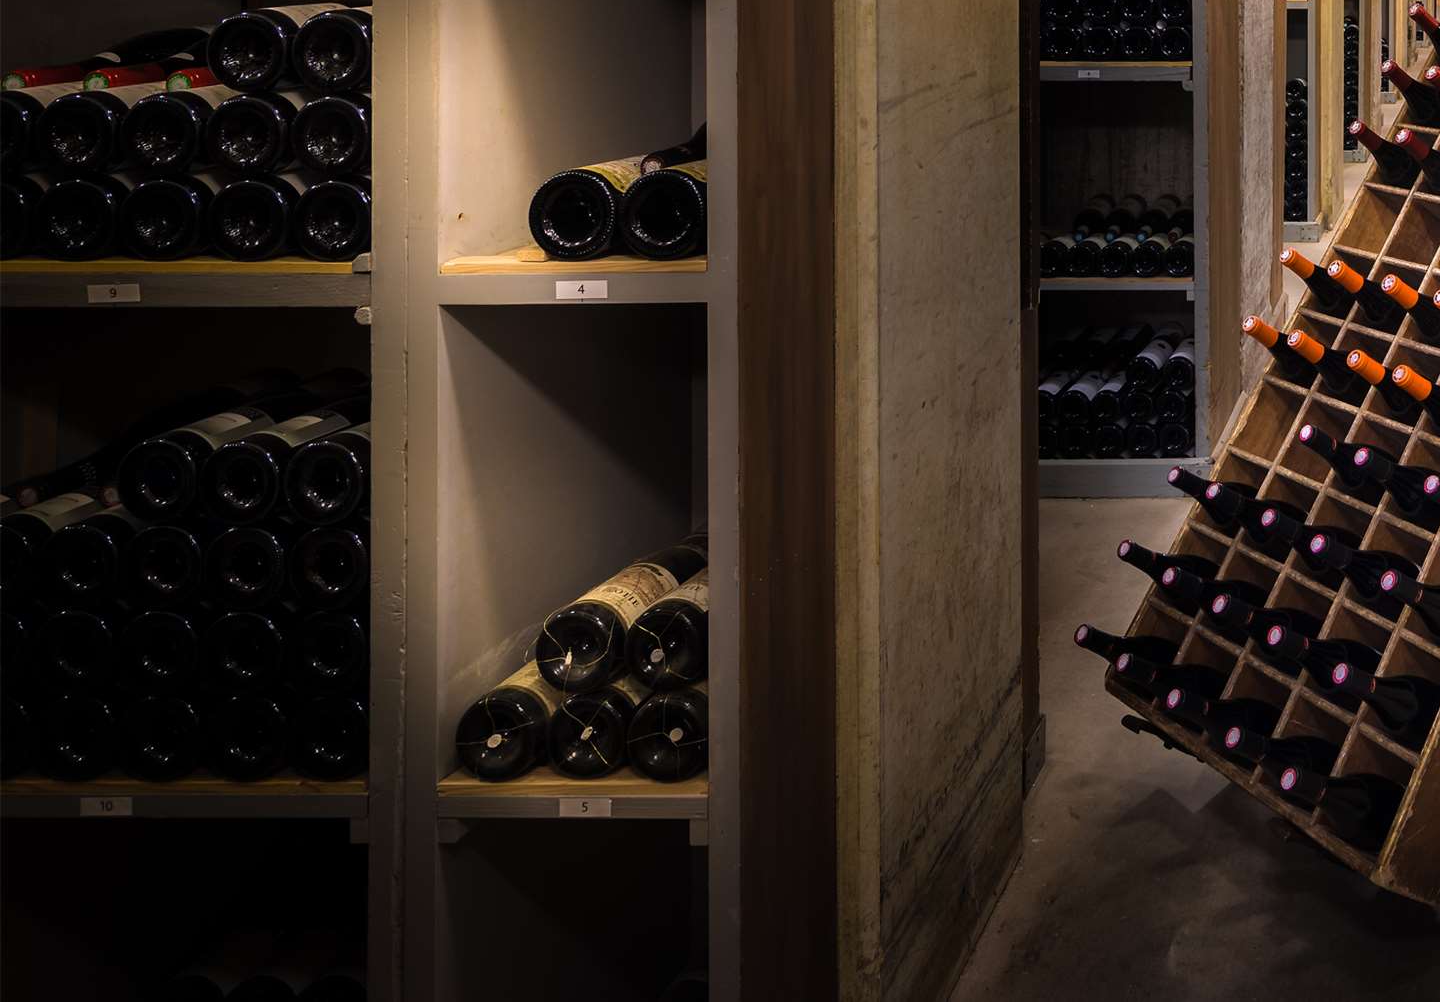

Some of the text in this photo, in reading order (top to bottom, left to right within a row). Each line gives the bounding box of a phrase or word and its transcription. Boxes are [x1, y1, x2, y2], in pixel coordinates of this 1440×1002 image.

[578, 285, 585, 295] 4
[100, 801, 113, 811] 10
[582, 802, 588, 812] 5
